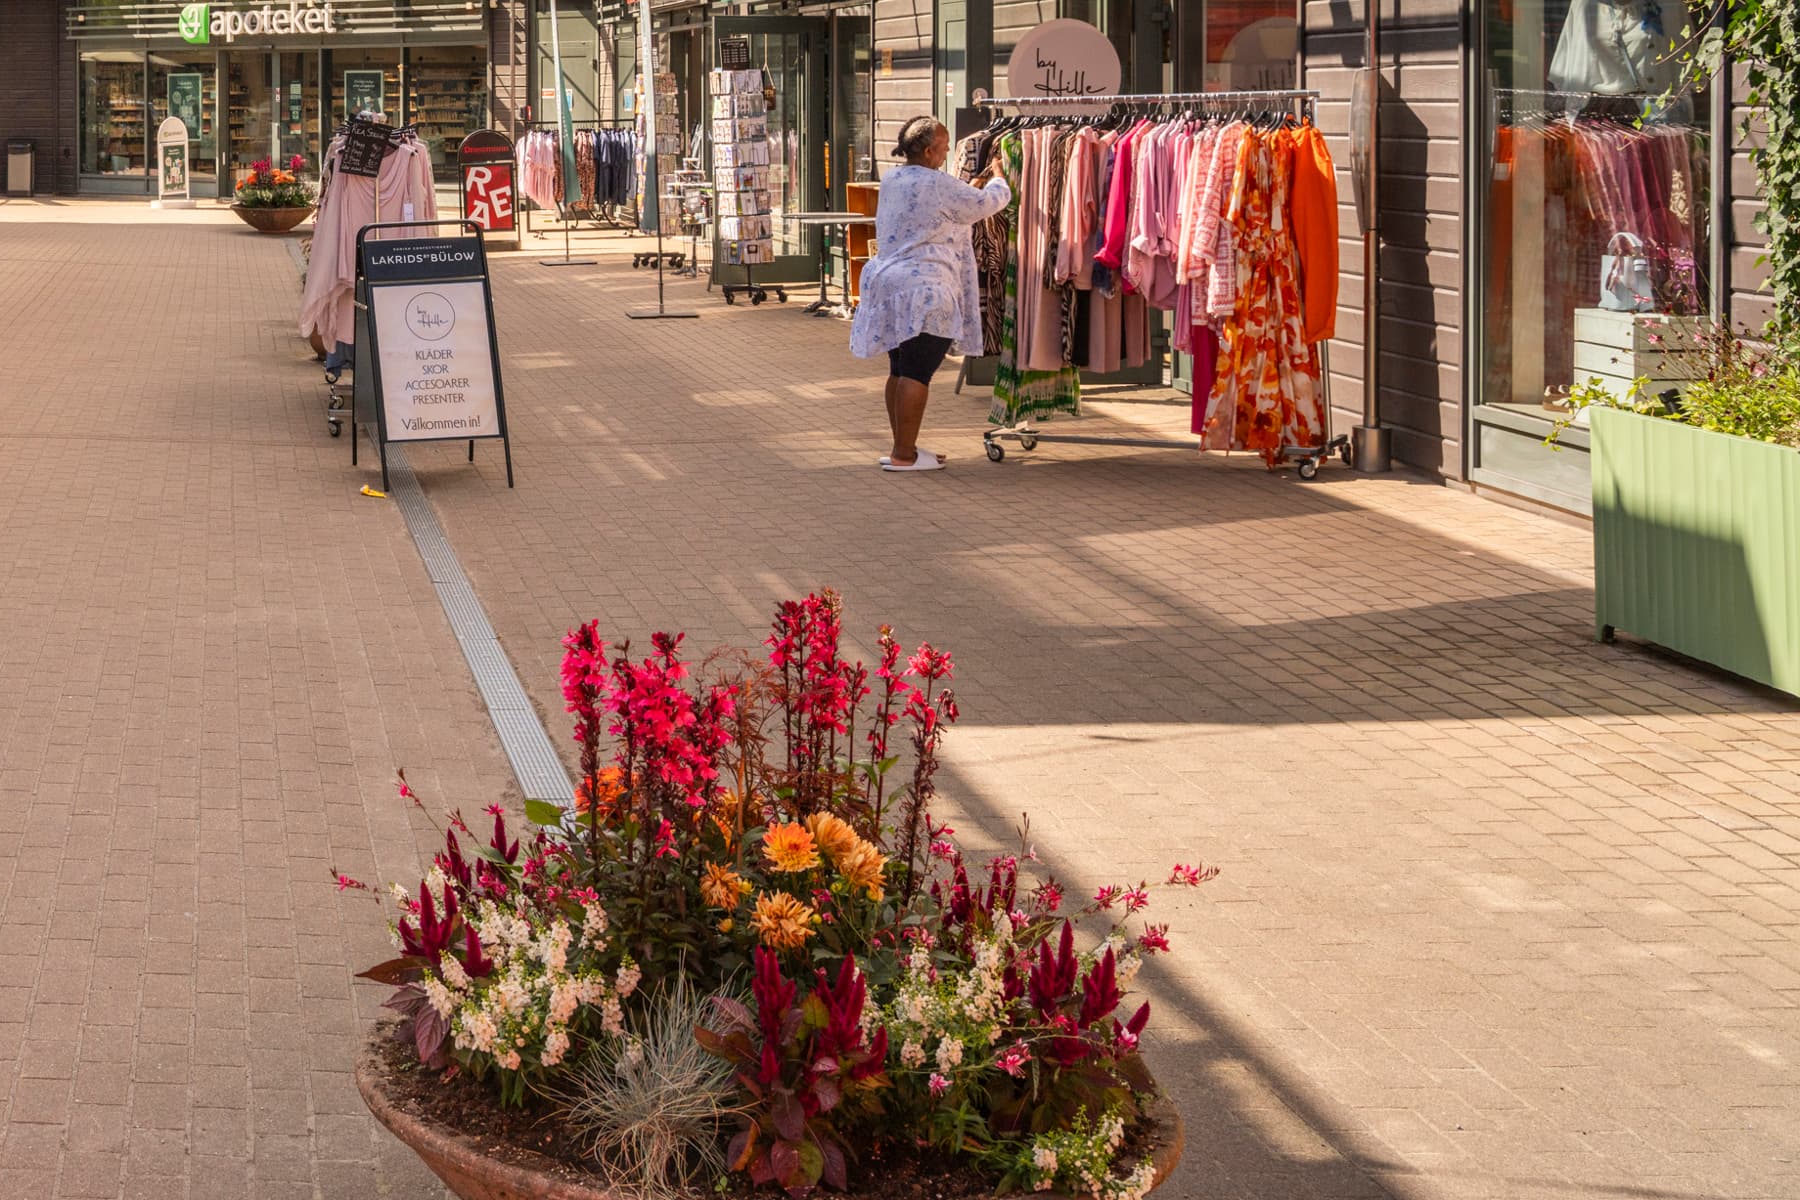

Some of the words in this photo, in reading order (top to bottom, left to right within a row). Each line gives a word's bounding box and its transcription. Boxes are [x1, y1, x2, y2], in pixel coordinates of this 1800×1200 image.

[210, 0, 337, 43] apoteket
[1035, 47, 1057, 80] by
[1033, 68, 1107, 98] Hille
[371, 254, 424, 265] LAKRIDS
[430, 251, 475, 263] BÜLOW
[415, 348, 454, 361] KLÄDER
[422, 363, 449, 376] SKOR
[404, 377, 471, 391] ACCESOARER
[412, 393, 466, 406] PRESENTER
[401, 417, 467, 431] Välkommen
[468, 415, 481, 428] in!
